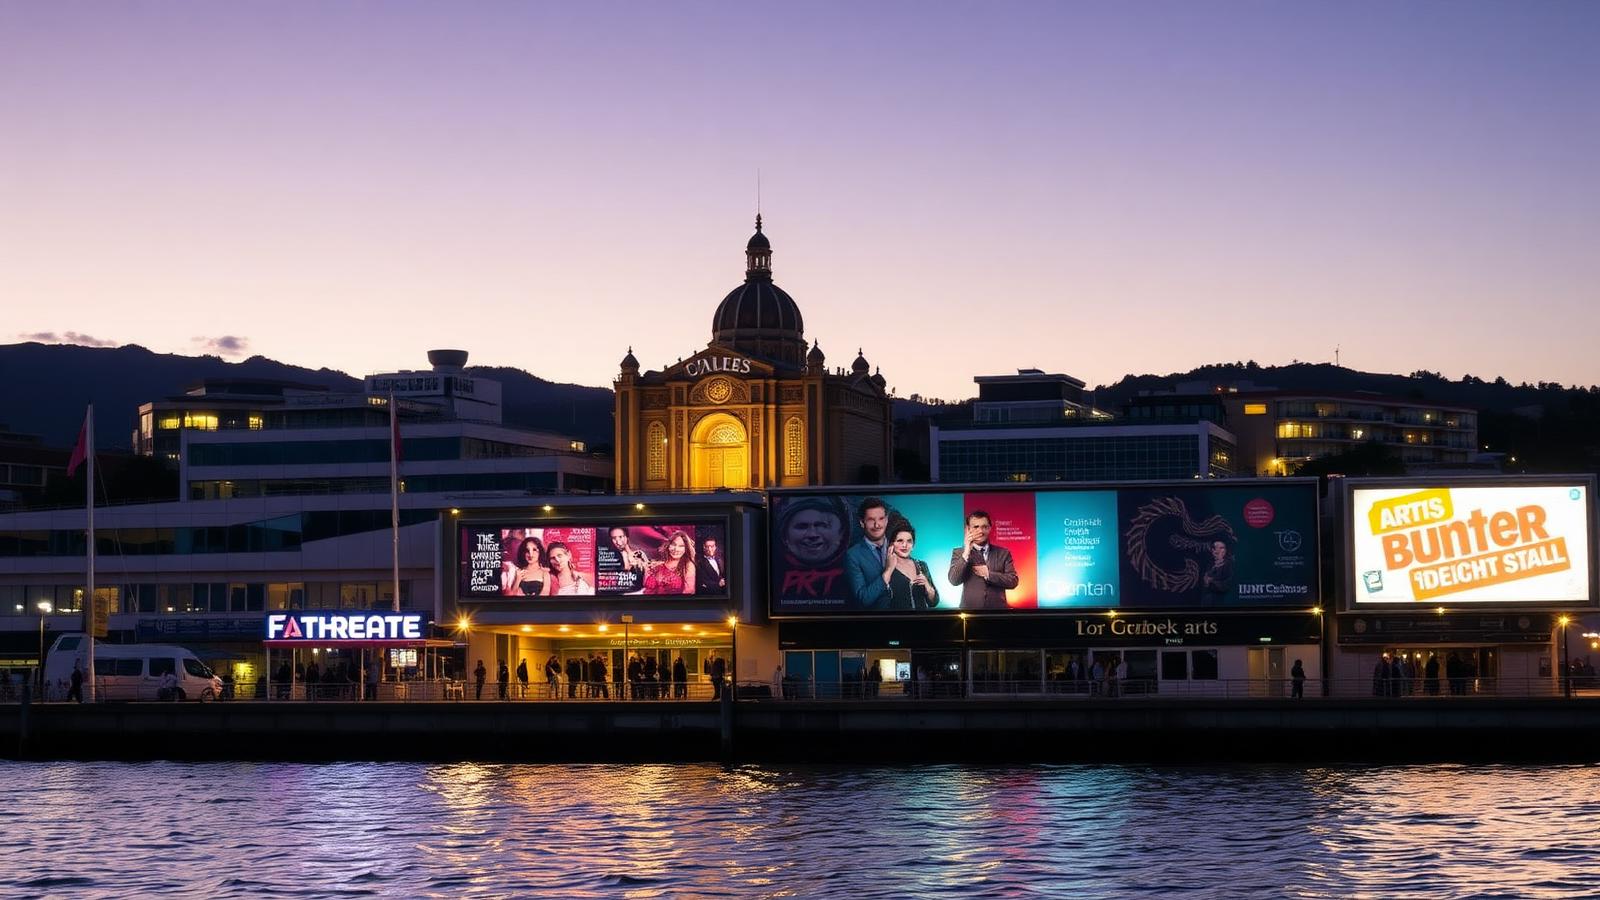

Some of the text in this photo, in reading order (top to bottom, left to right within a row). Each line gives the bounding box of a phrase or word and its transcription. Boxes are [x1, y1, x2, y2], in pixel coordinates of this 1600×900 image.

[1380, 497, 1446, 529] ARTIS
[1502, 541, 1567, 574] STALL
[268, 614, 421, 639] FATHREATE
[1184, 620, 1218, 635] arts
